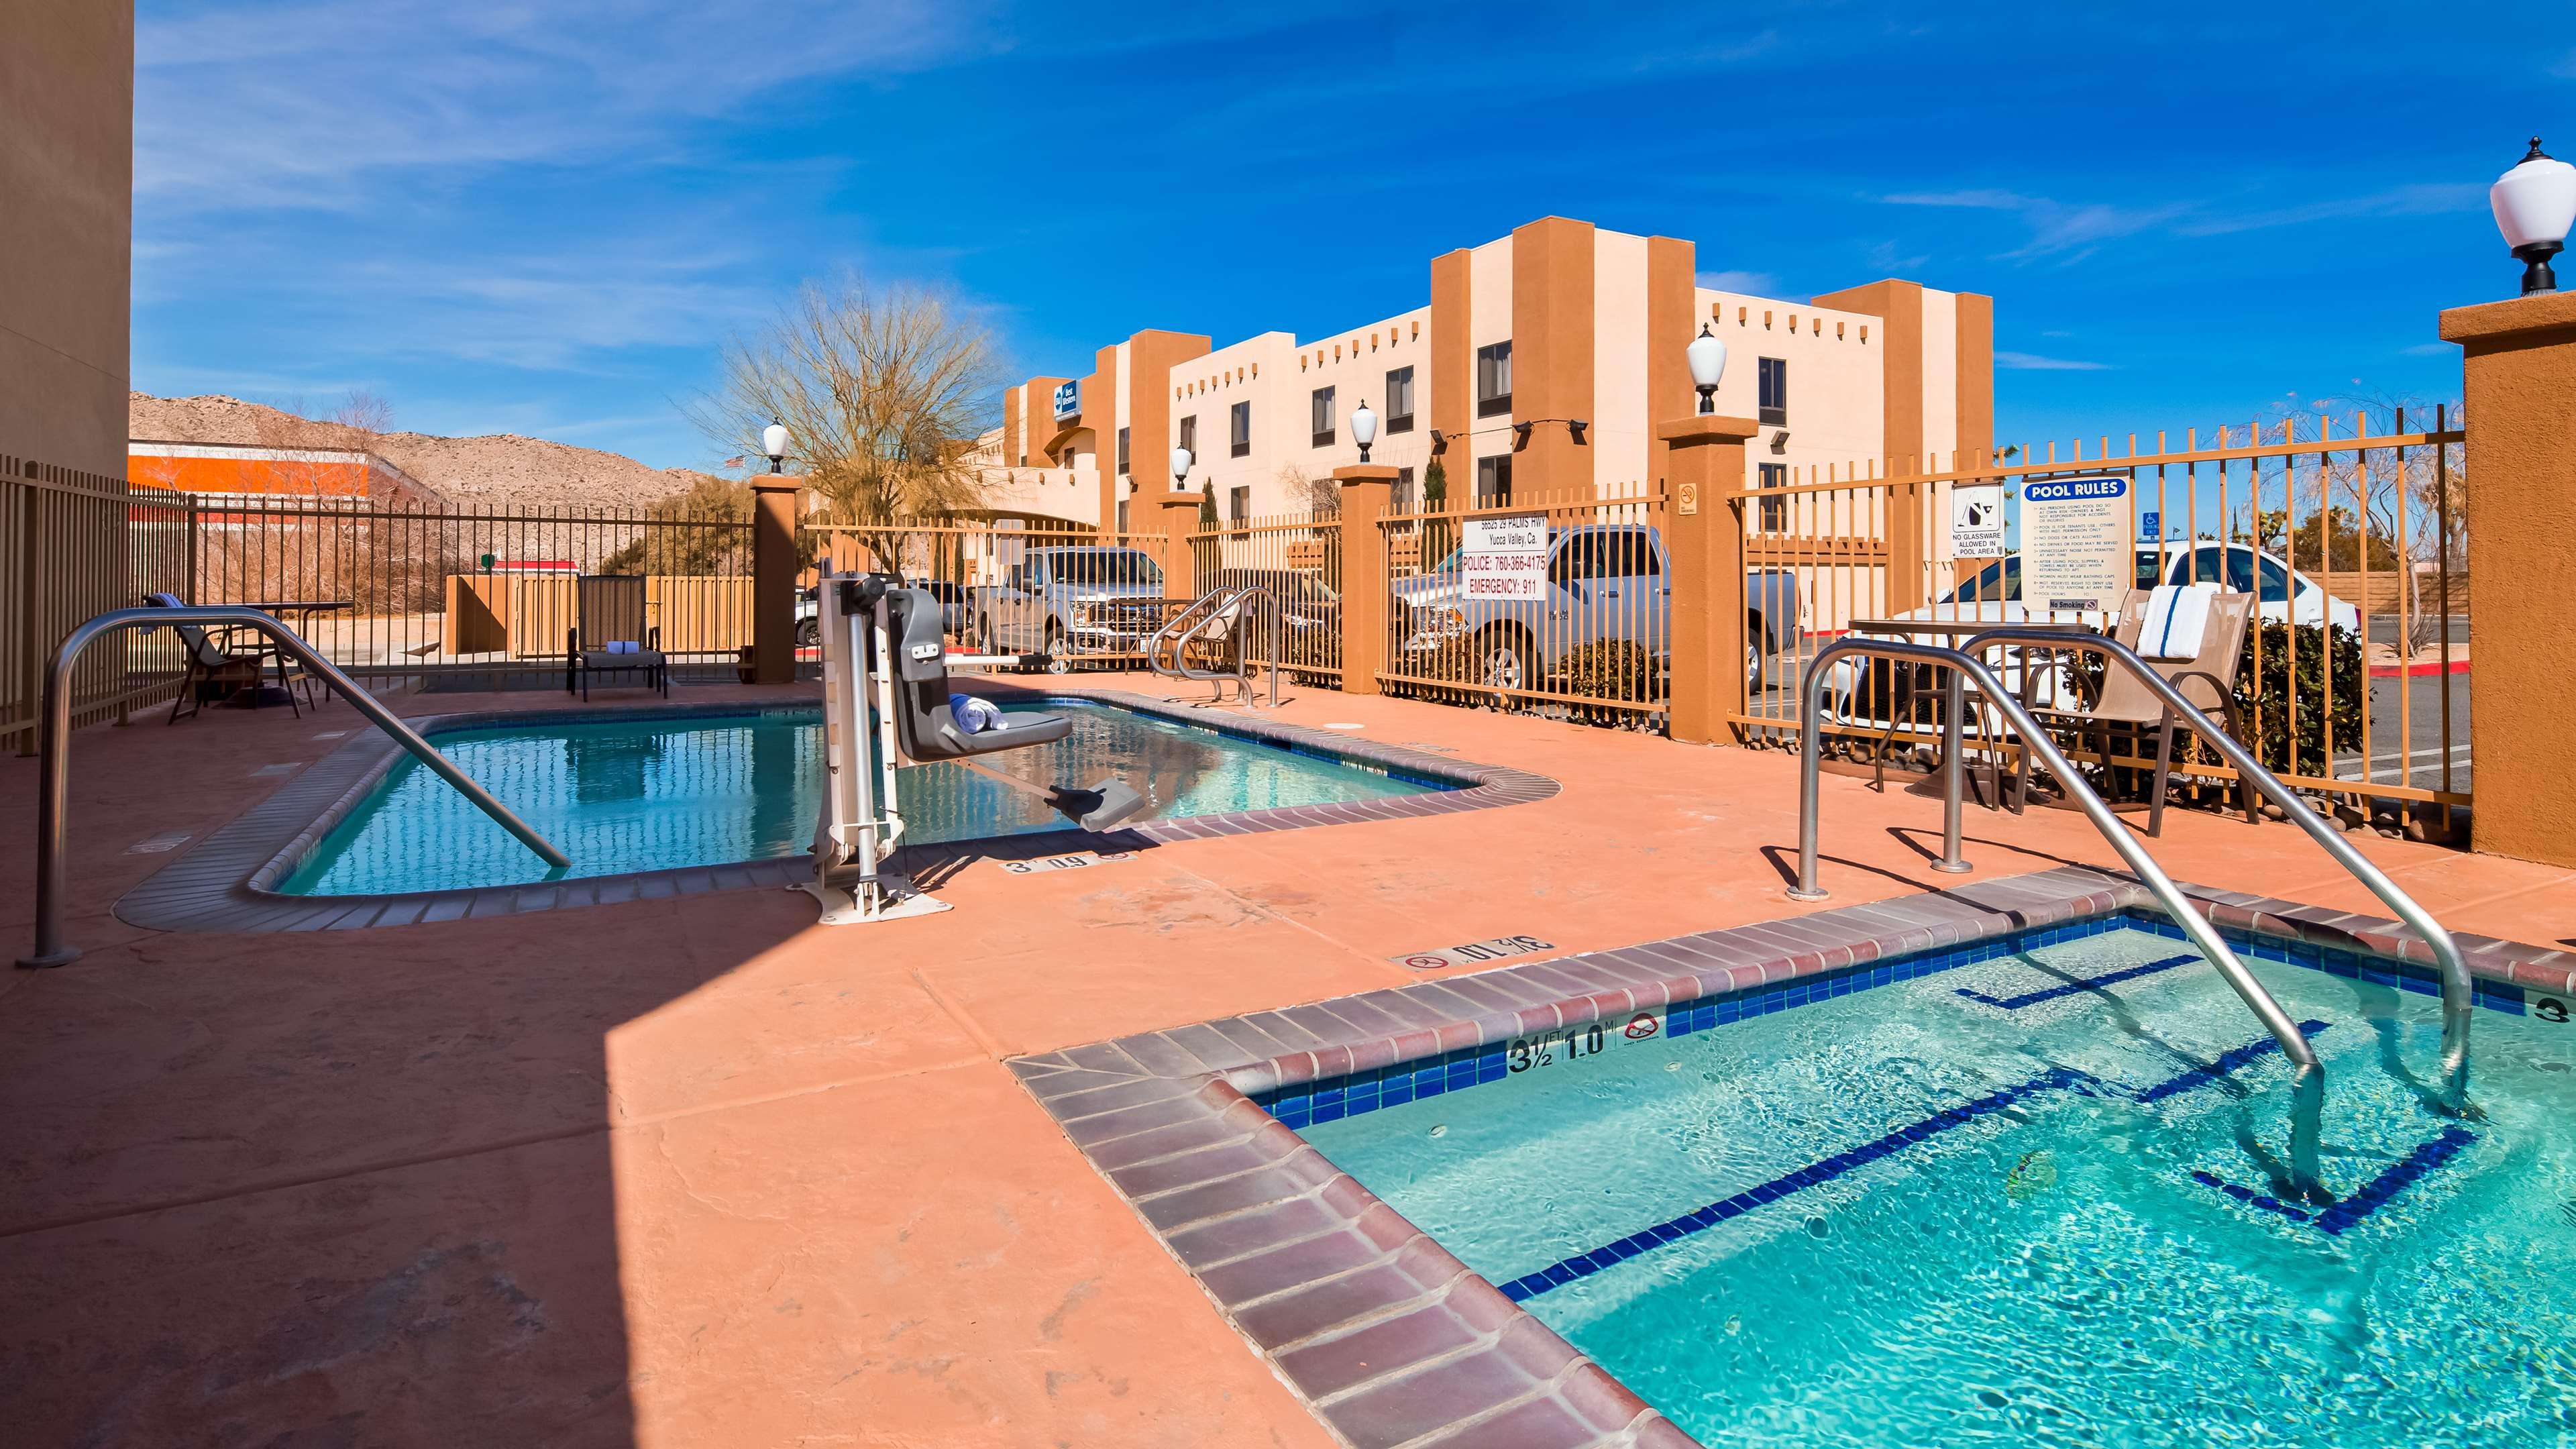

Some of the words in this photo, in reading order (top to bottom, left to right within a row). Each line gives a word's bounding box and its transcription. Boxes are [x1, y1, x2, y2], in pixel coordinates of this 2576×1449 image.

[2032, 485, 2071, 498] POOL
[2076, 482, 2118, 495] RULES
[1499, 518, 1506, 529] 29
[1509, 517, 1528, 529] PALMS
[1532, 515, 1546, 527] HWY
[1489, 534, 1506, 545] Yucca
[1508, 533, 1526, 547] Valley,
[1527, 532, 1537, 544] Ca.
[1464, 555, 1492, 571] POLICE:
[1495, 555, 1546, 571] 760-366-4175
[1470, 578, 1519, 594] EMERGENCY:
[1523, 579, 1536, 594] 911
[2059, 601, 2084, 609] Smoking
[1006, 862, 1032, 873] 3
[2534, 998, 2570, 1023] 3
[1565, 1024, 1603, 1059] 1.0
[1605, 1020, 1614, 1033] M
